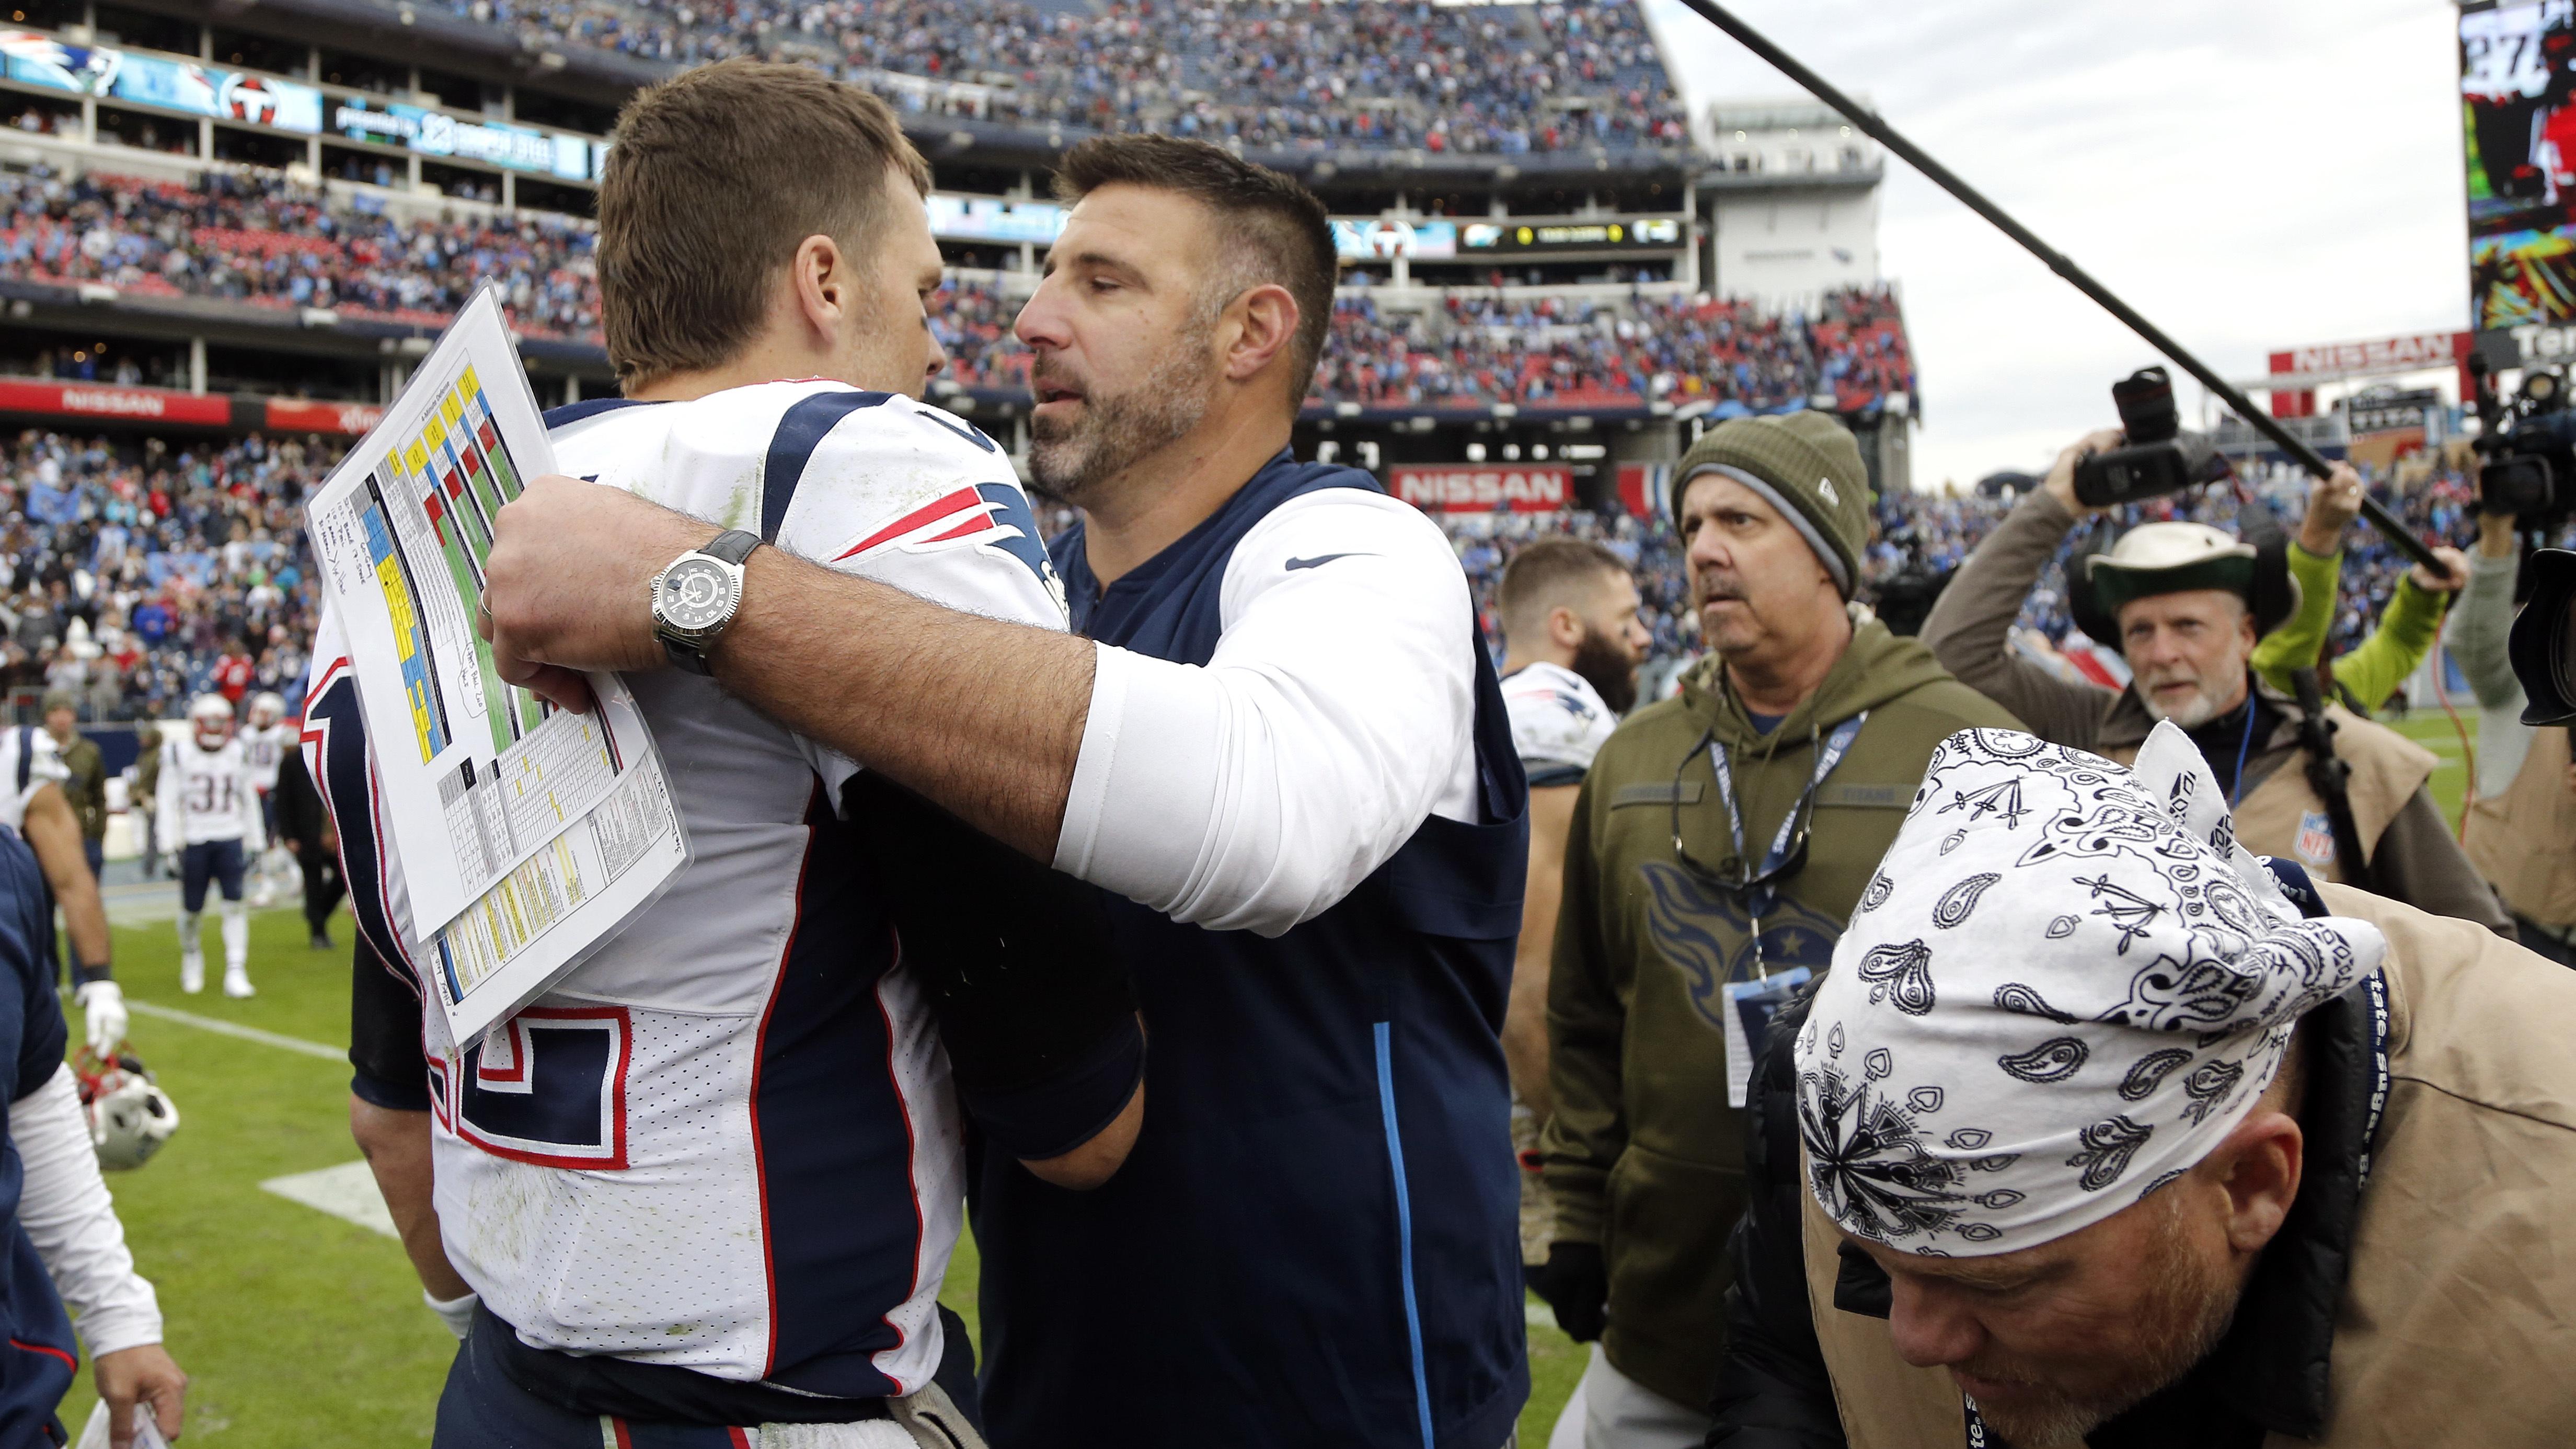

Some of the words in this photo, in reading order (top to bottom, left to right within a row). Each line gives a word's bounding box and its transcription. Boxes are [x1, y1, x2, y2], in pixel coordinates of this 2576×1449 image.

[2294, 335, 2453, 372] NISSAN
[62, 390, 164, 416] NISSAN
[1401, 473, 1563, 502] NISSAN
[192, 775, 232, 812] 31
